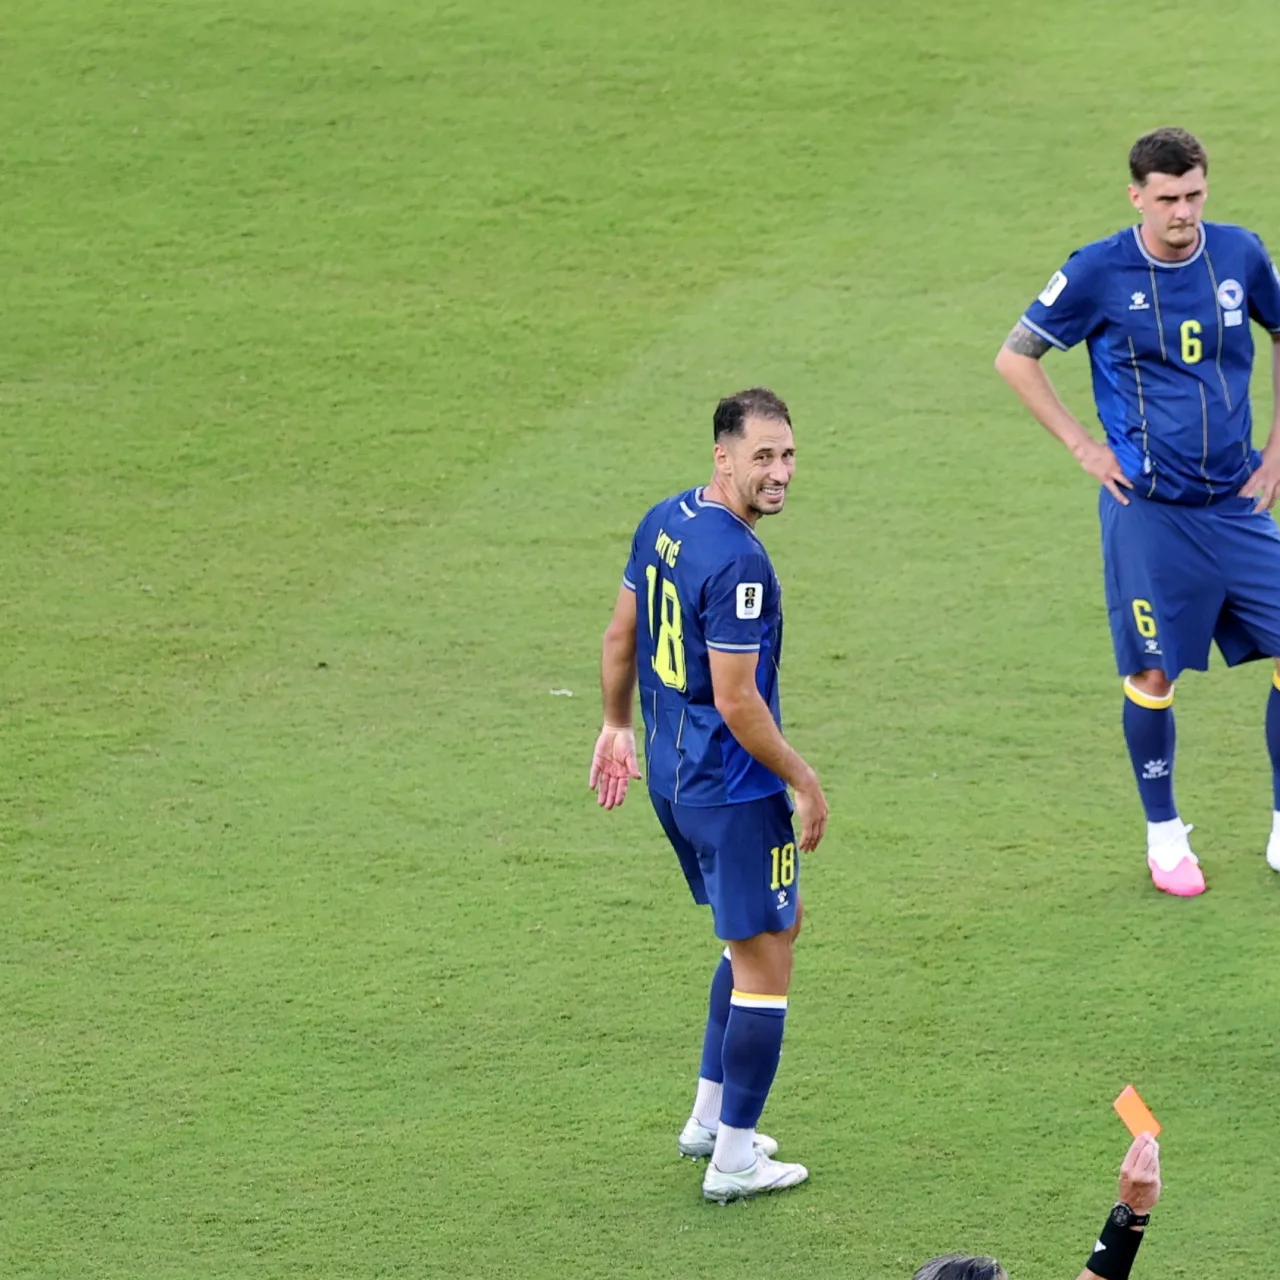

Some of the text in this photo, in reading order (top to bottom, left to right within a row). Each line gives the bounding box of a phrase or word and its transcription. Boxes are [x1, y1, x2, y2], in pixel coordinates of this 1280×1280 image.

[1180, 319, 1202, 364] 6
[645, 564, 687, 693] 18
[1132, 598, 1157, 638] 6
[770, 842, 795, 890] 18
